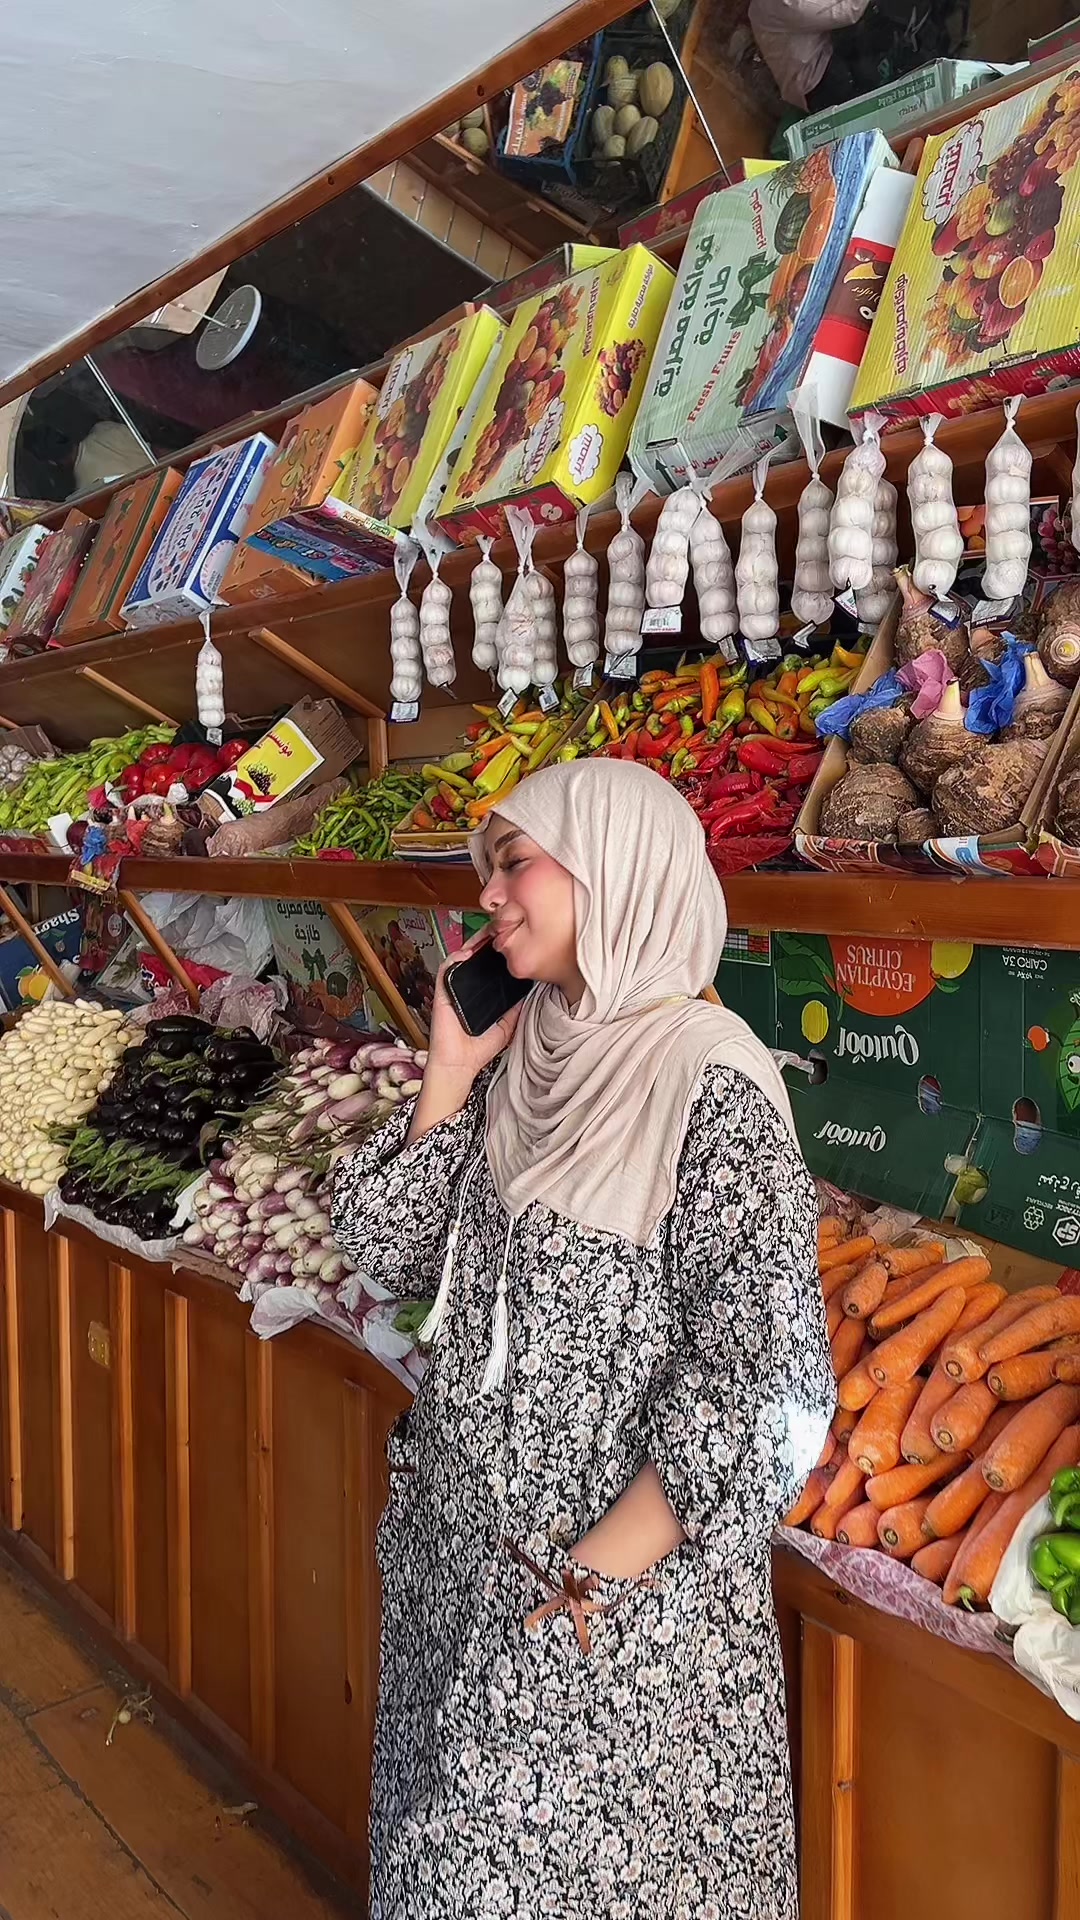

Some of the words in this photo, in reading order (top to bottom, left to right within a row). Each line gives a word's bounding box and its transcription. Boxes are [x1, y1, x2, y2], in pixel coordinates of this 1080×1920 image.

[677, 234, 714, 311] فواكة
[693, 265, 731, 346] طازجة
[653, 315, 691, 397] مصرية
[687, 378, 715, 423] Fresh
[712, 330, 742, 376] Fruits
[295, 924, 320, 944] طازجة
[847, 945, 901, 970] CITRUS
[1002, 955, 1016, 966] 3A
[1017, 957, 1047, 971] CAIRO
[836, 963, 913, 992] EGYPTIAN
[834, 1024, 919, 1066] Qutoof
[813, 1120, 887, 1152] Qutoof
